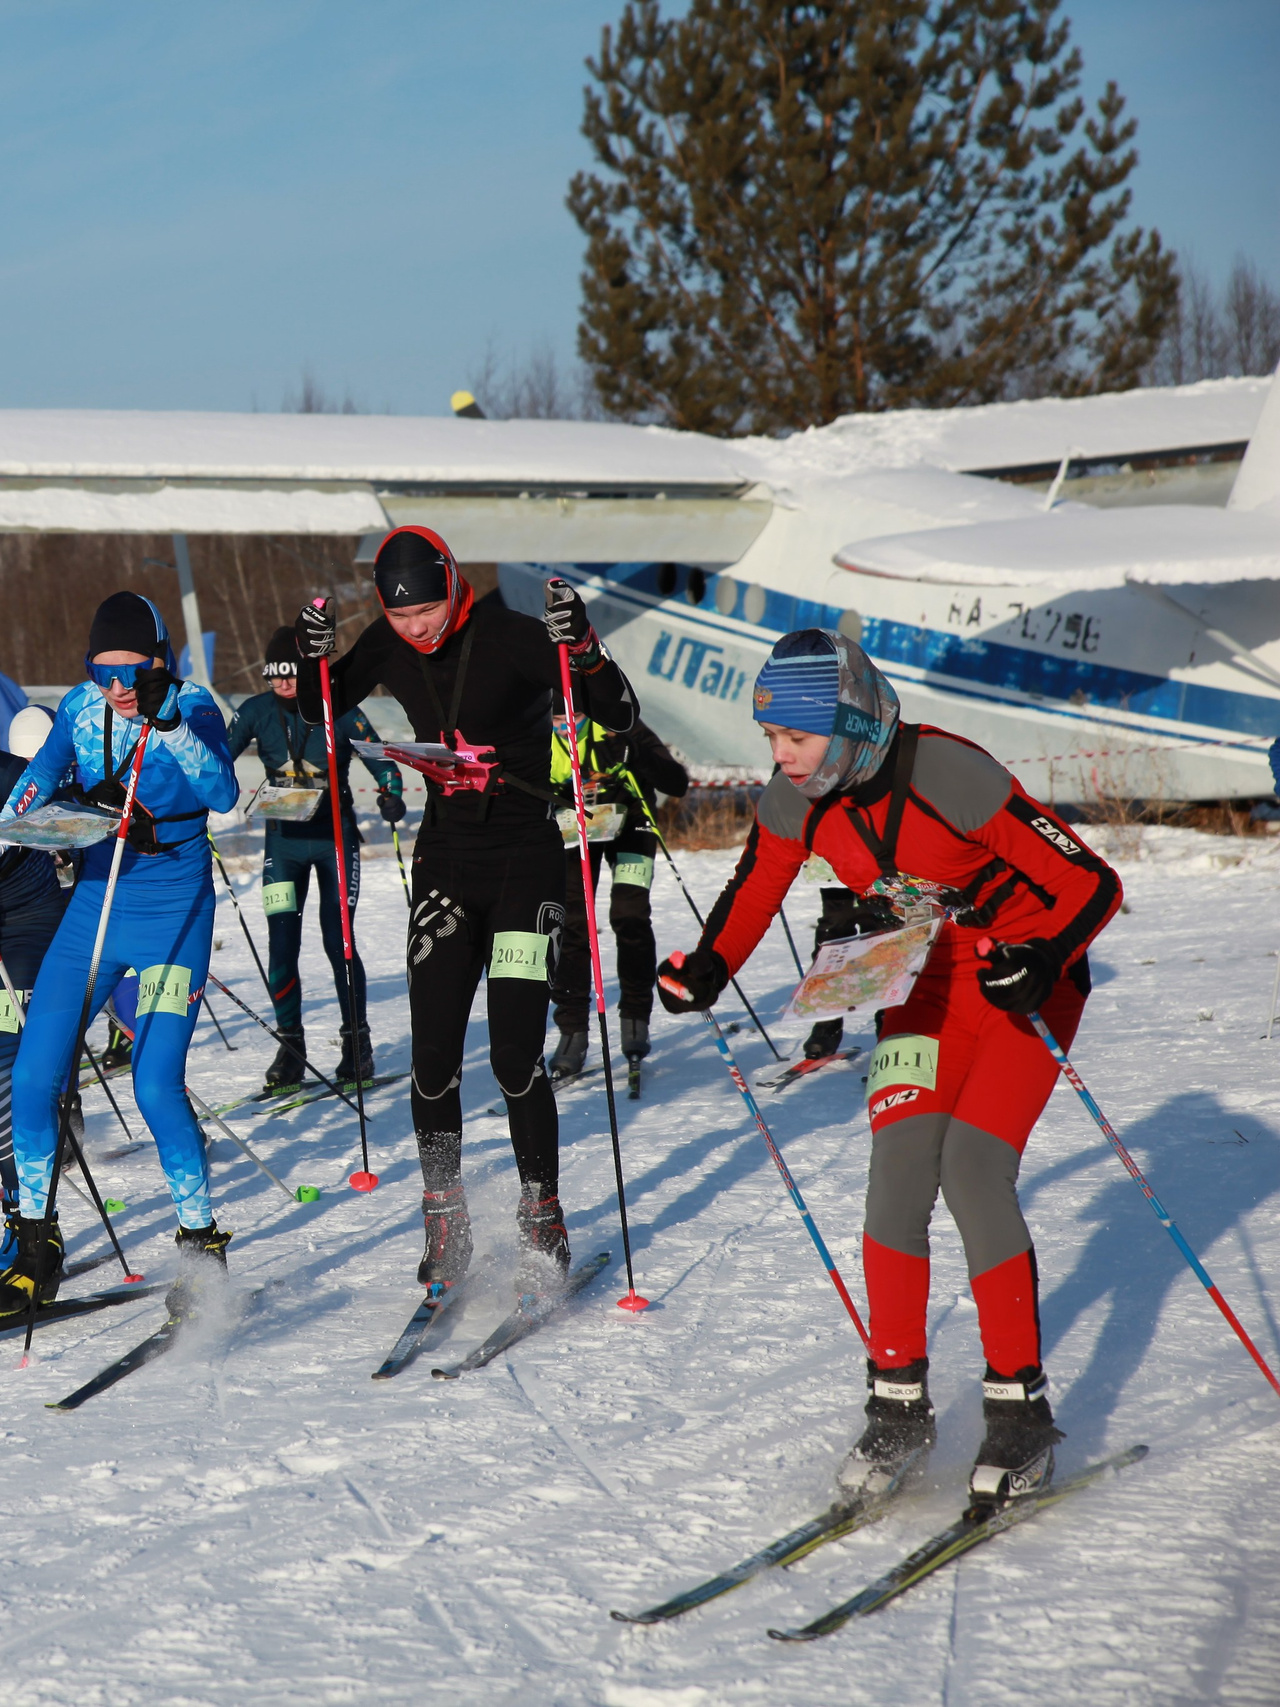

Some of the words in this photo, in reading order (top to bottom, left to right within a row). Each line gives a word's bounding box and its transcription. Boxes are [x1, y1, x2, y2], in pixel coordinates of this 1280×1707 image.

[647, 630, 747, 702] UTair
[1035, 820, 1079, 852] KV+
[265, 892, 290, 906] 212.1
[497, 948, 538, 966] 202.1
[142, 980, 181, 999] 203.1
[870, 1050, 921, 1077] 201.1
[271, 1083, 301, 1097] BRADOS
